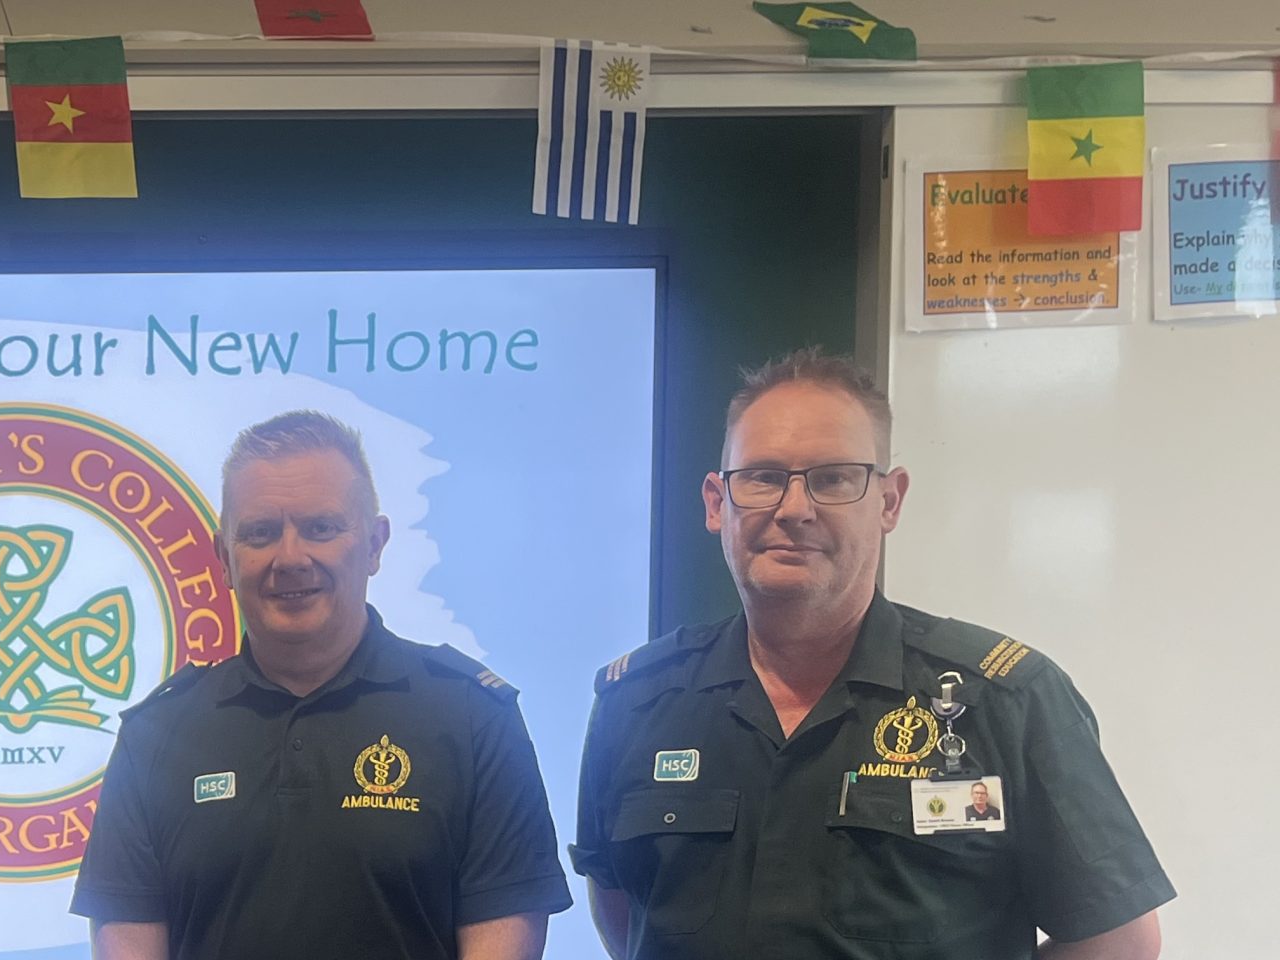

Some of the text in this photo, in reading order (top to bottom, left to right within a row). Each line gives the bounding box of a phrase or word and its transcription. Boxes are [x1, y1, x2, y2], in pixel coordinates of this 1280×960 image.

[1173, 173, 1266, 201] Justify
[1173, 231, 1236, 251] Explain
[927, 246, 1111, 265] Read the information and
[1174, 258, 1219, 276] made
[928, 268, 1098, 287] look at the strengths &
[927, 295, 1007, 309] weaknesses
[145, 314, 298, 376] New
[327, 309, 539, 374] Home
[70, 448, 223, 667] COLLEG
[662, 757, 689, 772] HSC
[200, 779, 226, 794] HSC
[341, 795, 420, 812] AMBULANCE
